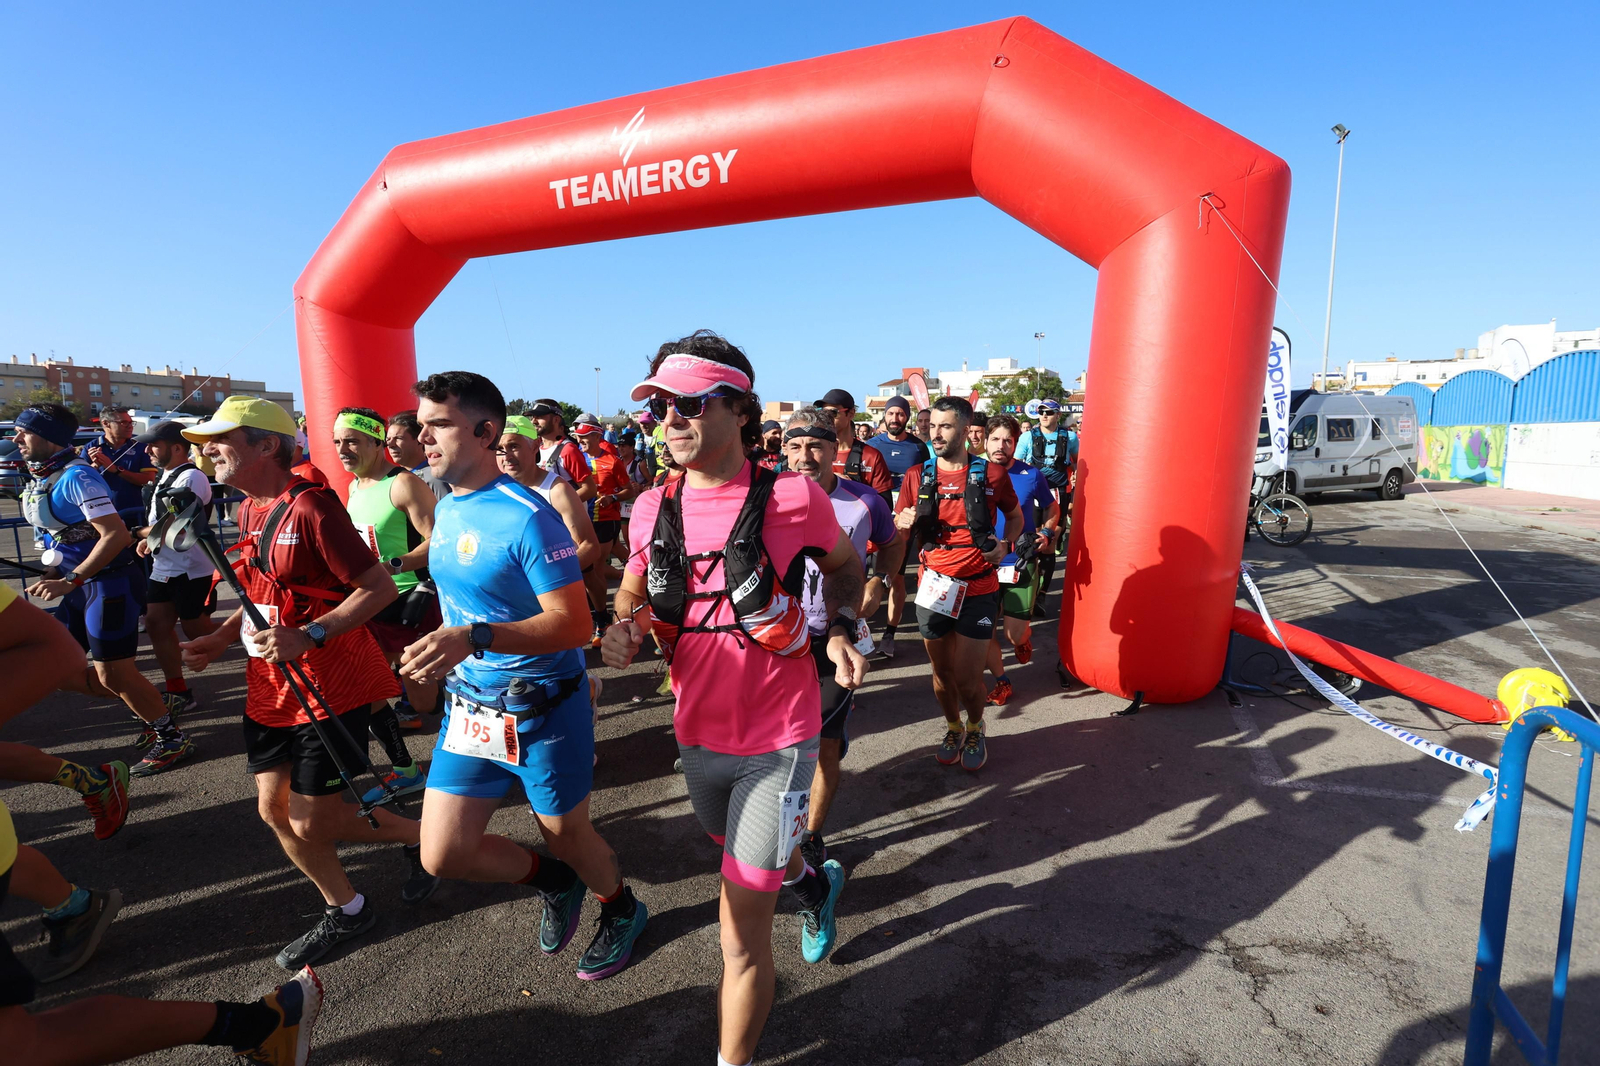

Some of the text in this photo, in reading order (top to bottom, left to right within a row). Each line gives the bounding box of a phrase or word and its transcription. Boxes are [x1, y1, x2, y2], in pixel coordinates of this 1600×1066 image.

[549, 149, 738, 209] TEAMERGY
[544, 547, 577, 564] LEBRI
[464, 717, 491, 743] 195
[504, 723, 517, 756] PIRATA
